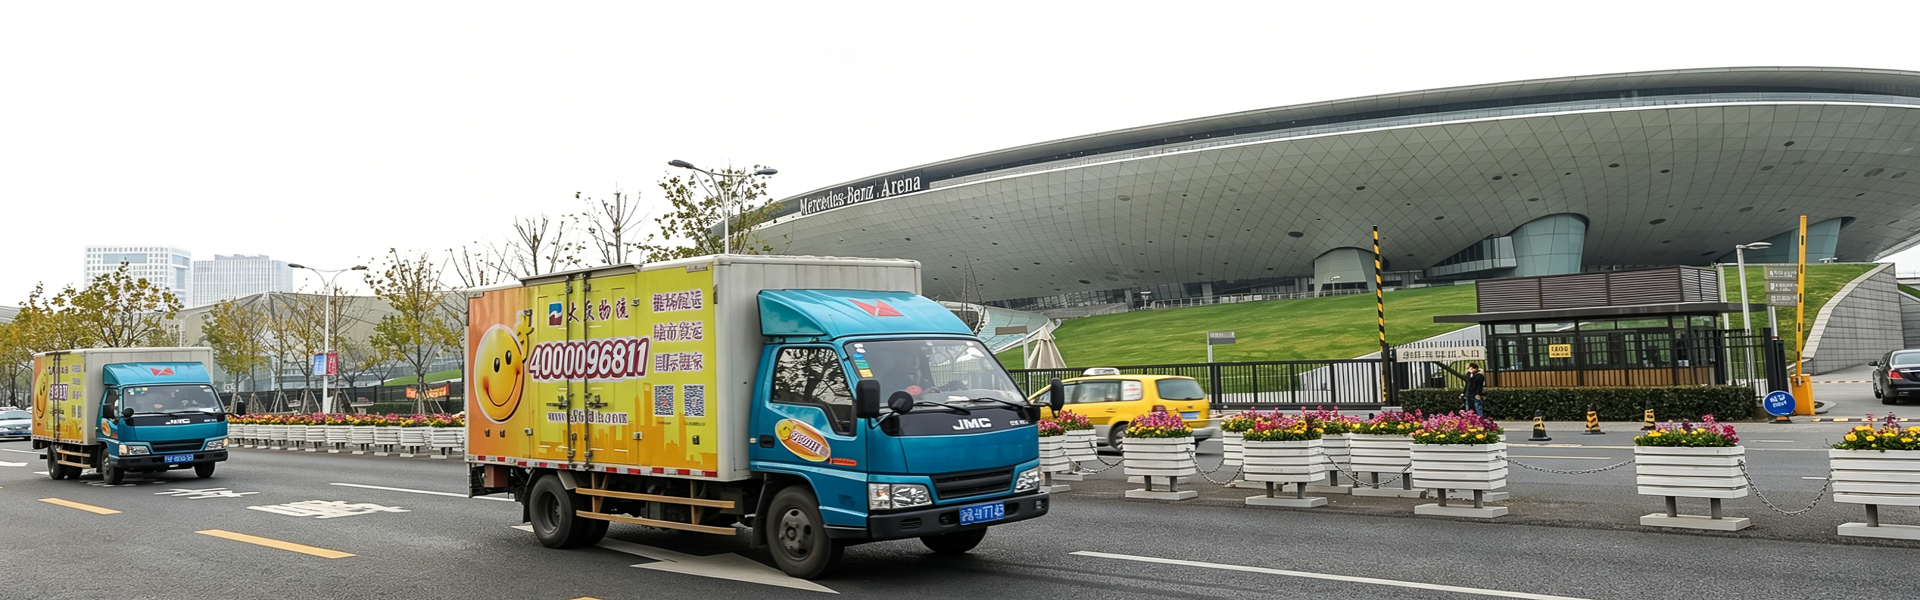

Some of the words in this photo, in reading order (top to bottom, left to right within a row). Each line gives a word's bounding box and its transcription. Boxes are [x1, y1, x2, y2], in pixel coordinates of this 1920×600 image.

[799, 186, 875, 216] Mercedes-Benz
[880, 176, 921, 199] Arena
[529, 338, 650, 380] 4000096811
[952, 417, 992, 430] JMC
